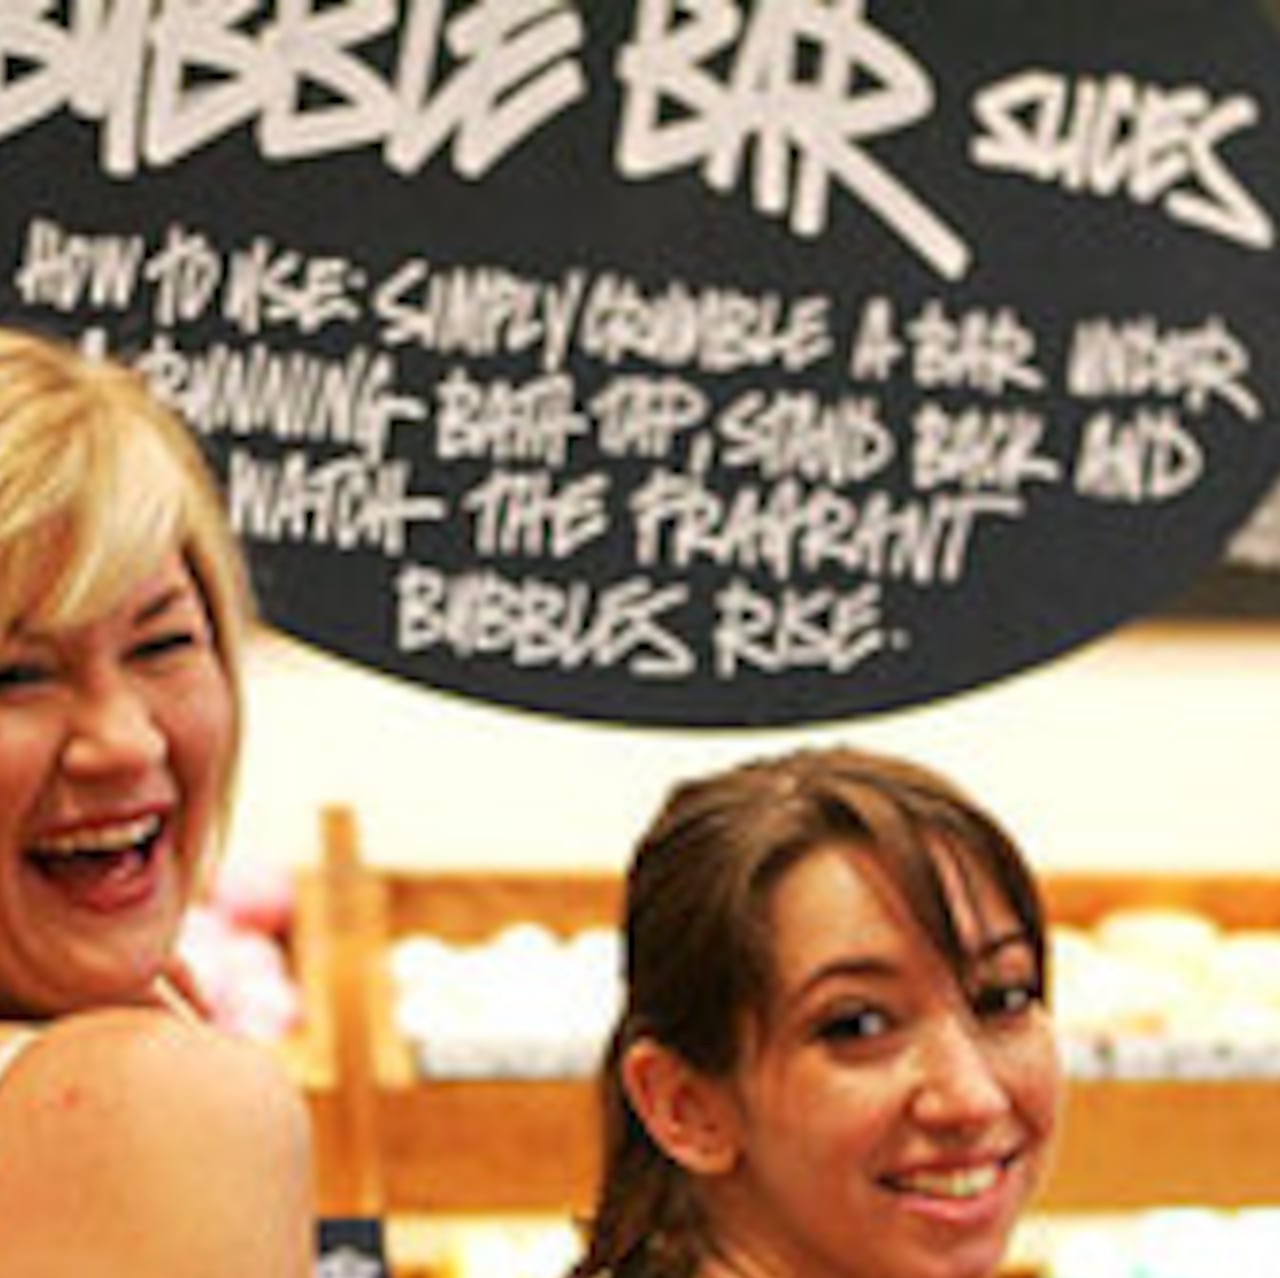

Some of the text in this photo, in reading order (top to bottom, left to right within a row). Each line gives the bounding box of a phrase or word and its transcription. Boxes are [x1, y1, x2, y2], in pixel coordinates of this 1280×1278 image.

[614, 0, 972, 282] BAR
[969, 70, 1276, 252] SLICES
[14, 217, 144, 312] HOW
[144, 222, 220, 327] TO
[374, 258, 588, 374] SIMPLY
[580, 270, 834, 371] CRUMBLE
[849, 297, 904, 383] A
[905, 299, 1048, 395] BAR
[1067, 314, 1263, 420] UNDER
[138, 334, 428, 468] RUNNING
[433, 366, 588, 470] BATH
[718, 388, 897, 487] STAND
[909, 402, 1063, 492] BACK
[1073, 405, 1205, 504] AND
[228, 448, 1027, 584] WATCH THE FRAGRANT
[394, 562, 912, 680] BUBBLES RISE.
